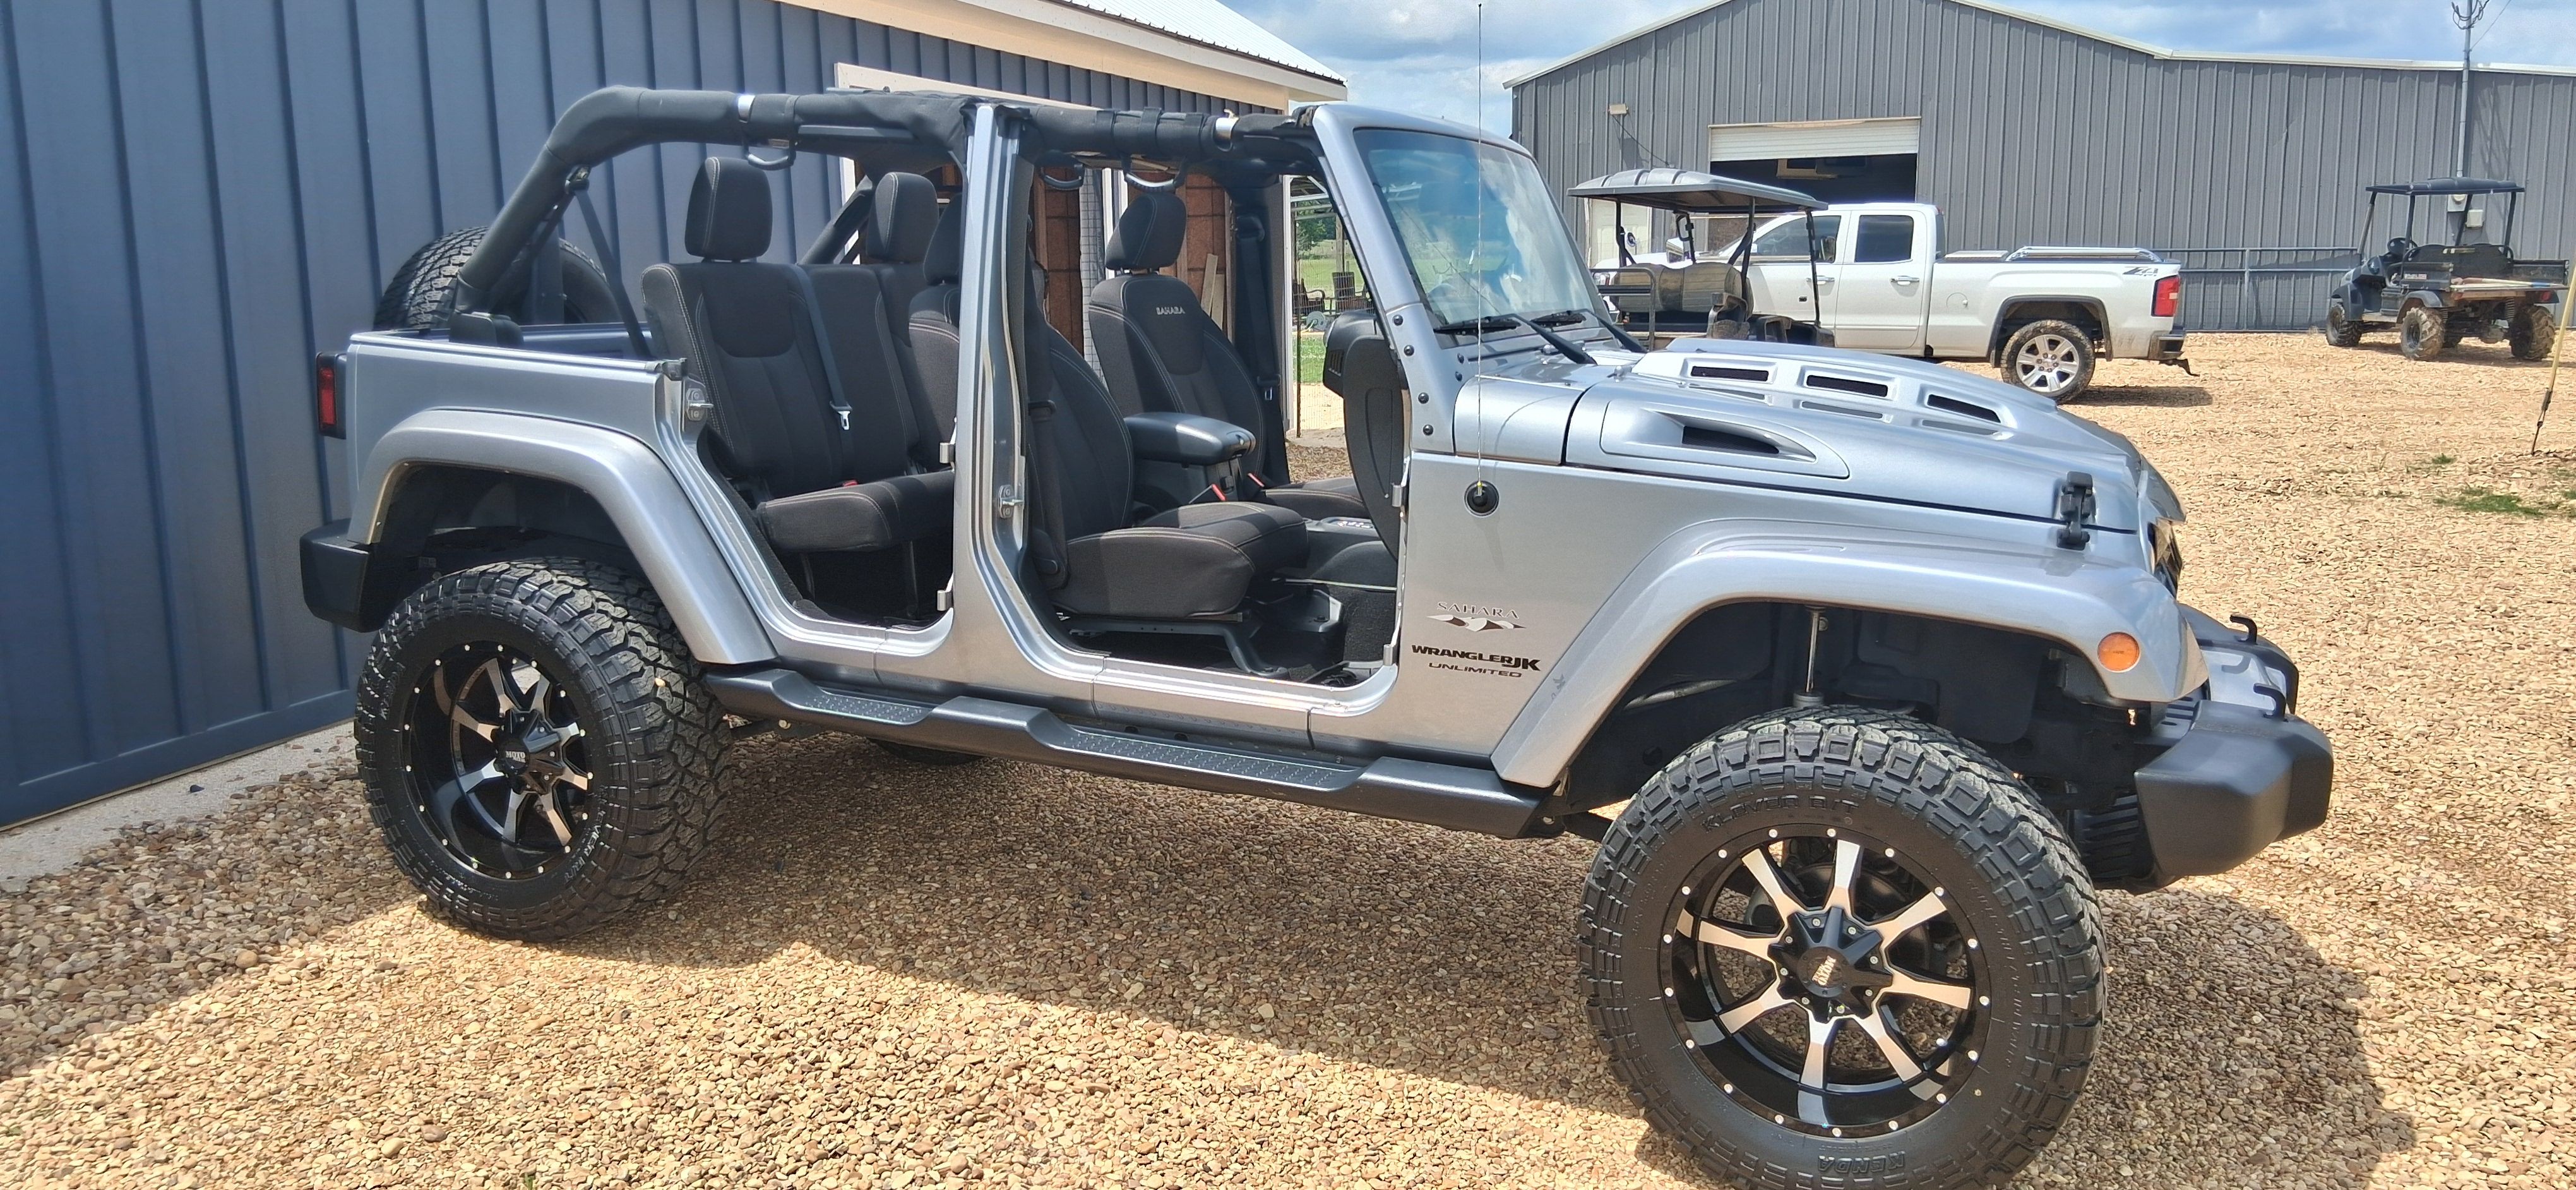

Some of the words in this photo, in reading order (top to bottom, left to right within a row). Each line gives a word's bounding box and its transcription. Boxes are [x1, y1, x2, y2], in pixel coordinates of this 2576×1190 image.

[1155, 306, 1186, 315] SAHARA
[1436, 601, 1520, 620] SAHARA
[1428, 662, 1523, 678] UNLIMITED
[505, 750, 526, 759] MOTO
[1700, 793, 1799, 834] KLEVER
[1808, 795, 1859, 814] R/T
[1816, 1151, 1907, 1174] KENDA
